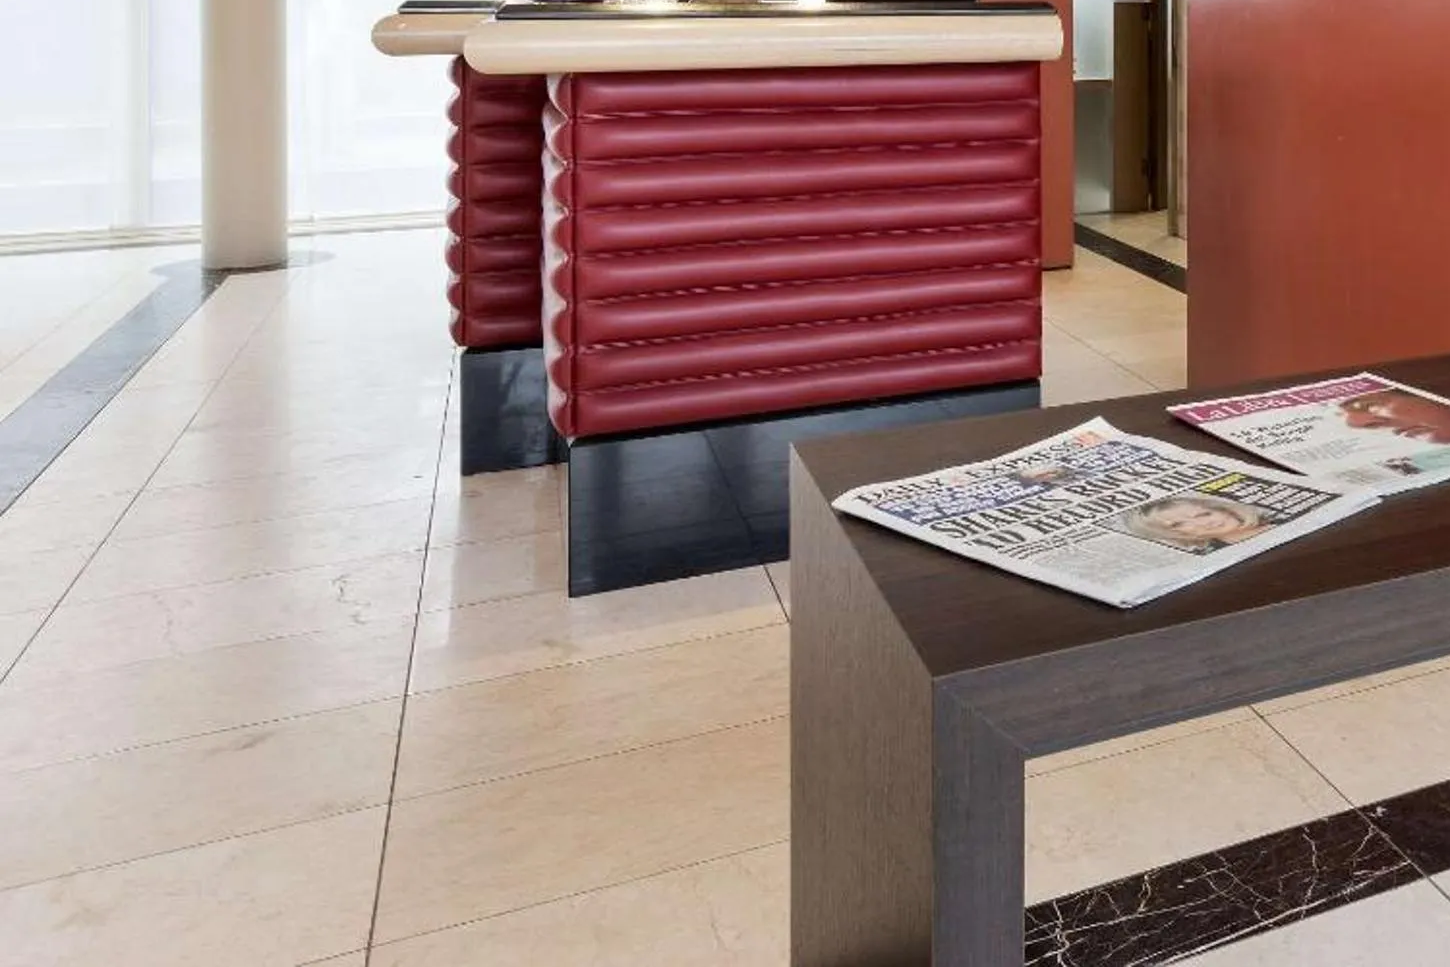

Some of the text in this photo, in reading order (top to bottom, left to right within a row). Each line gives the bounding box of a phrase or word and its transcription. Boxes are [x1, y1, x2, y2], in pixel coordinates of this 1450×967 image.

[929, 493, 1073, 539] SHARES
[1064, 450, 1187, 498] ROCKET
[1024, 488, 1152, 535] RECORD
[1144, 462, 1229, 493] HIGH
